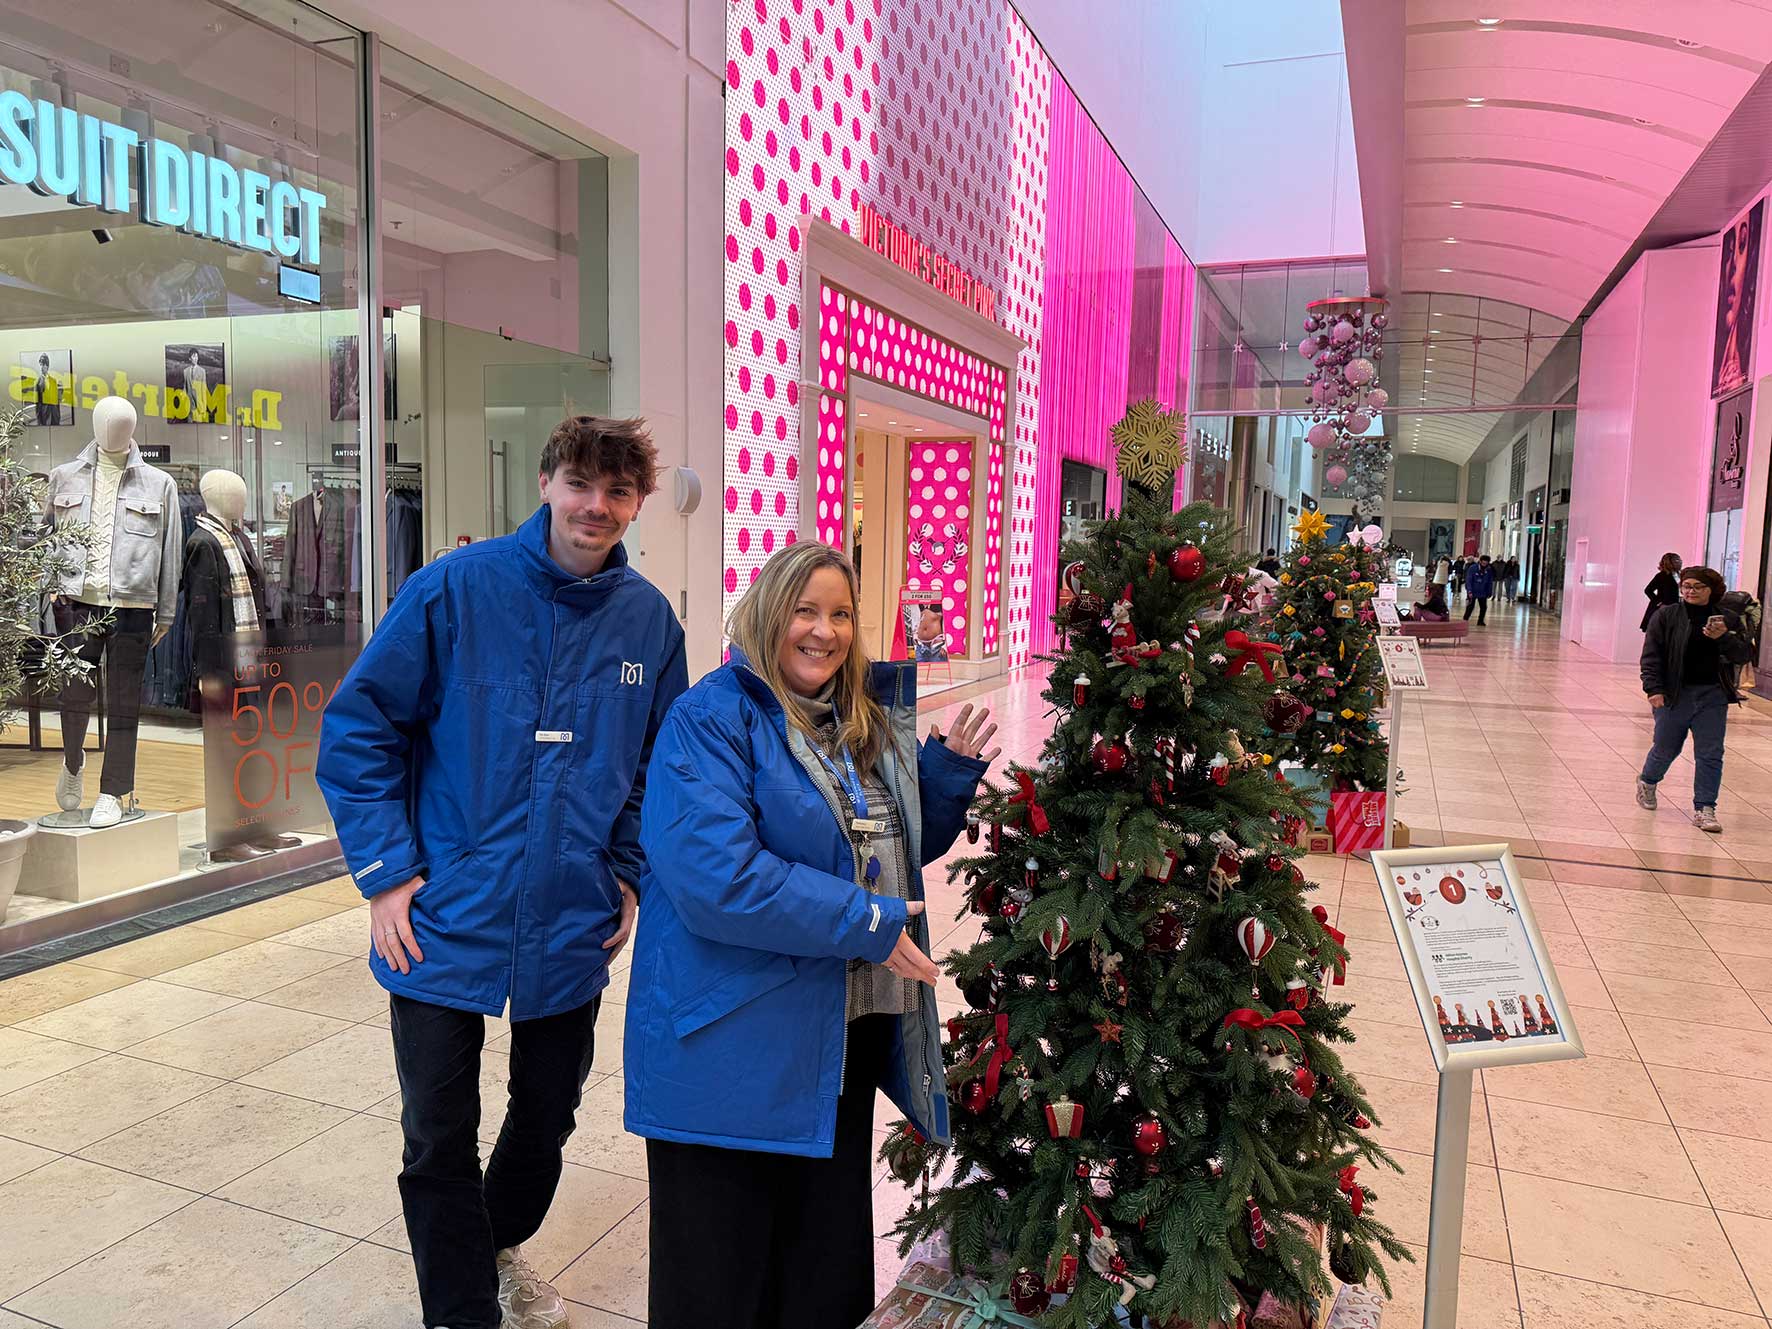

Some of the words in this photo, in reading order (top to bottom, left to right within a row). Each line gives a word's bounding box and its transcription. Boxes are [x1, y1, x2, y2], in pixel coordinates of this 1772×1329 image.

[0, 90, 139, 213] SUIT
[152, 139, 326, 264] DIRECT
[859, 200, 932, 284] VICTORIA'S
[933, 253, 973, 308] SECRET
[974, 280, 997, 323] PINK
[294, 643, 313, 655] SALE
[261, 662, 281, 679] TO
[1448, 884, 1457, 897] 1
